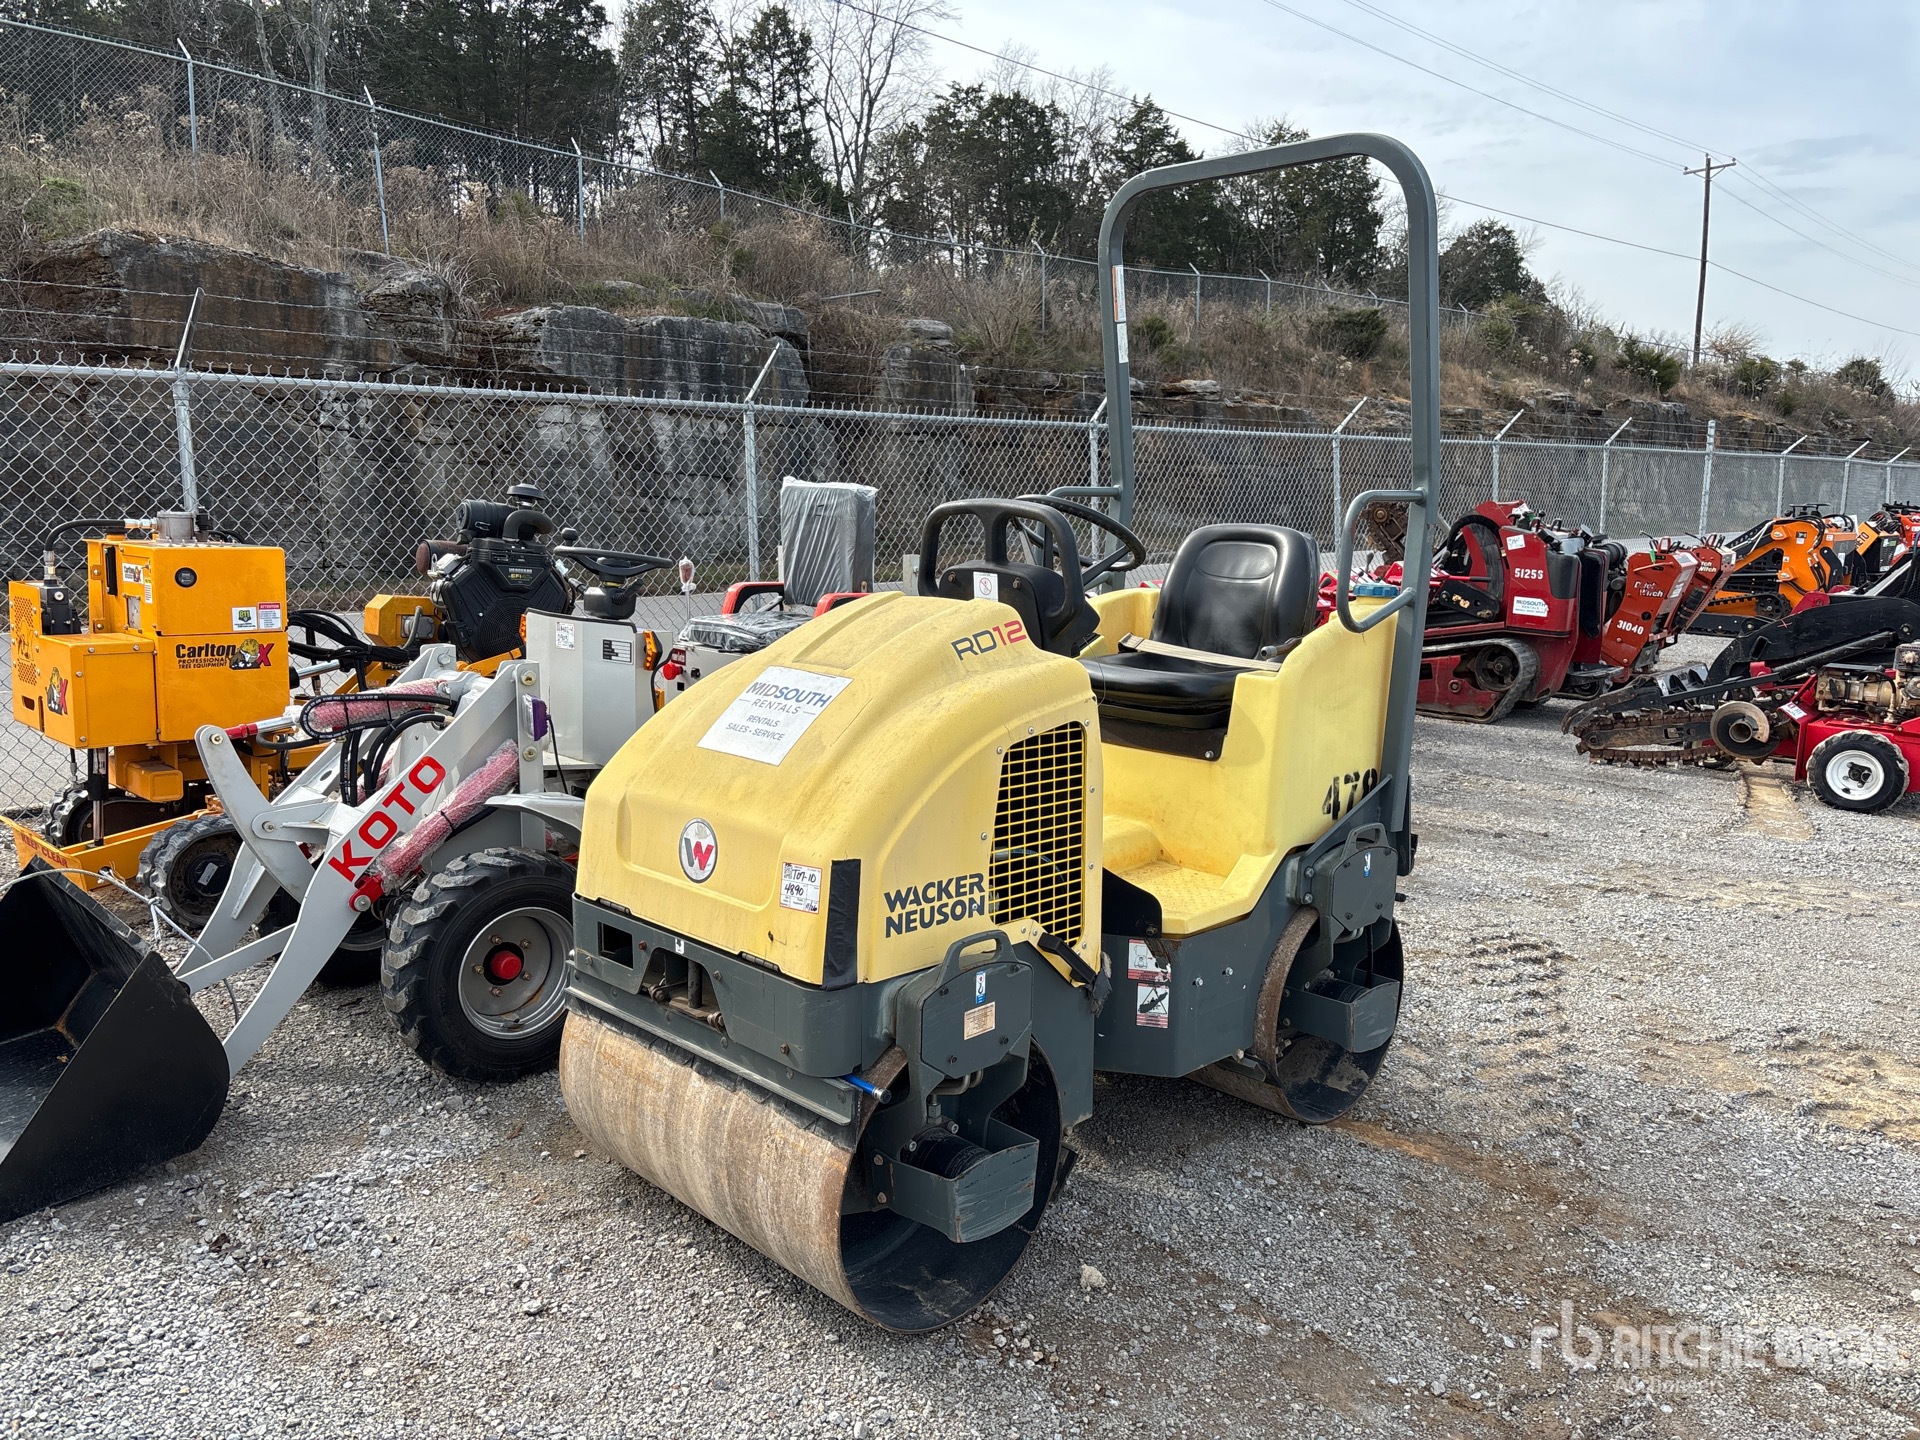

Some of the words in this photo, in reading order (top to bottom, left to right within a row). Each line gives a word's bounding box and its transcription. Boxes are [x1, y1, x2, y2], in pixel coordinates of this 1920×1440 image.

[1616, 620, 1645, 635] 31040
[951, 620, 1027, 661] RD12
[175, 643, 237, 658] Carlton
[177, 656, 228, 665] PROFESSIONAL
[193, 661, 228, 669] EQUIPMENT
[746, 681, 833, 708] MIDSOUTH
[751, 698, 801, 715] RENTALS
[746, 714, 780, 728] RENTALS
[726, 722, 750, 734] SALES
[752, 728, 785, 741] SERVICE
[327, 755, 447, 883] KOTO
[41, 846, 69, 869] CLEAR
[784, 882, 804, 896] 4890
[883, 872, 986, 914] WACKER
[885, 894, 986, 939] NEUSON
